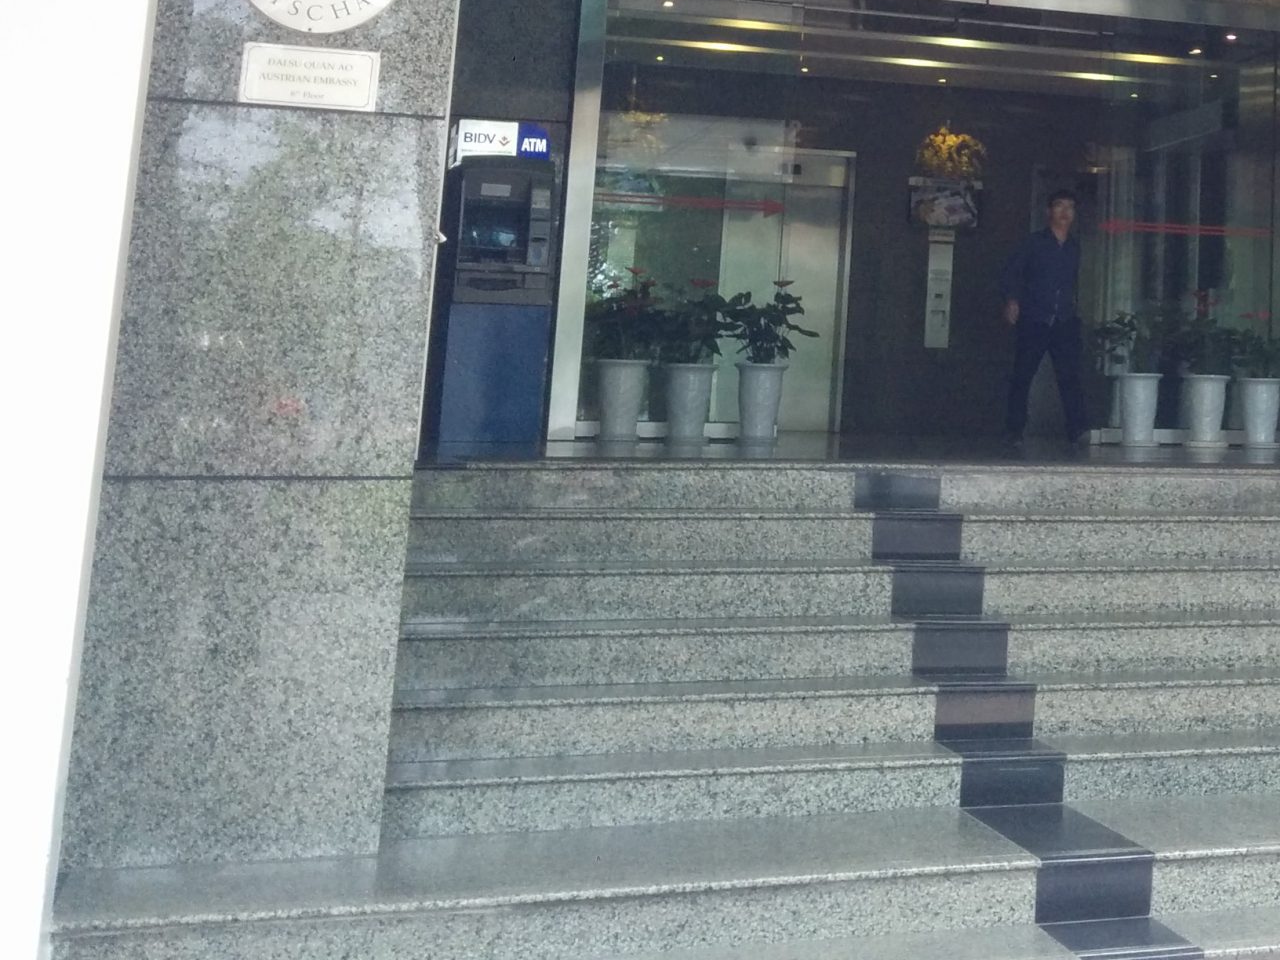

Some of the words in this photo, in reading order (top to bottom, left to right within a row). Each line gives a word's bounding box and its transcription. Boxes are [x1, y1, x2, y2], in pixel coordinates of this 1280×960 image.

[260, 72, 310, 83] AUSTRIAN
[313, 76, 360, 88] EMBASSY
[463, 131, 497, 144] BIDV
[521, 137, 547, 153] ATM
